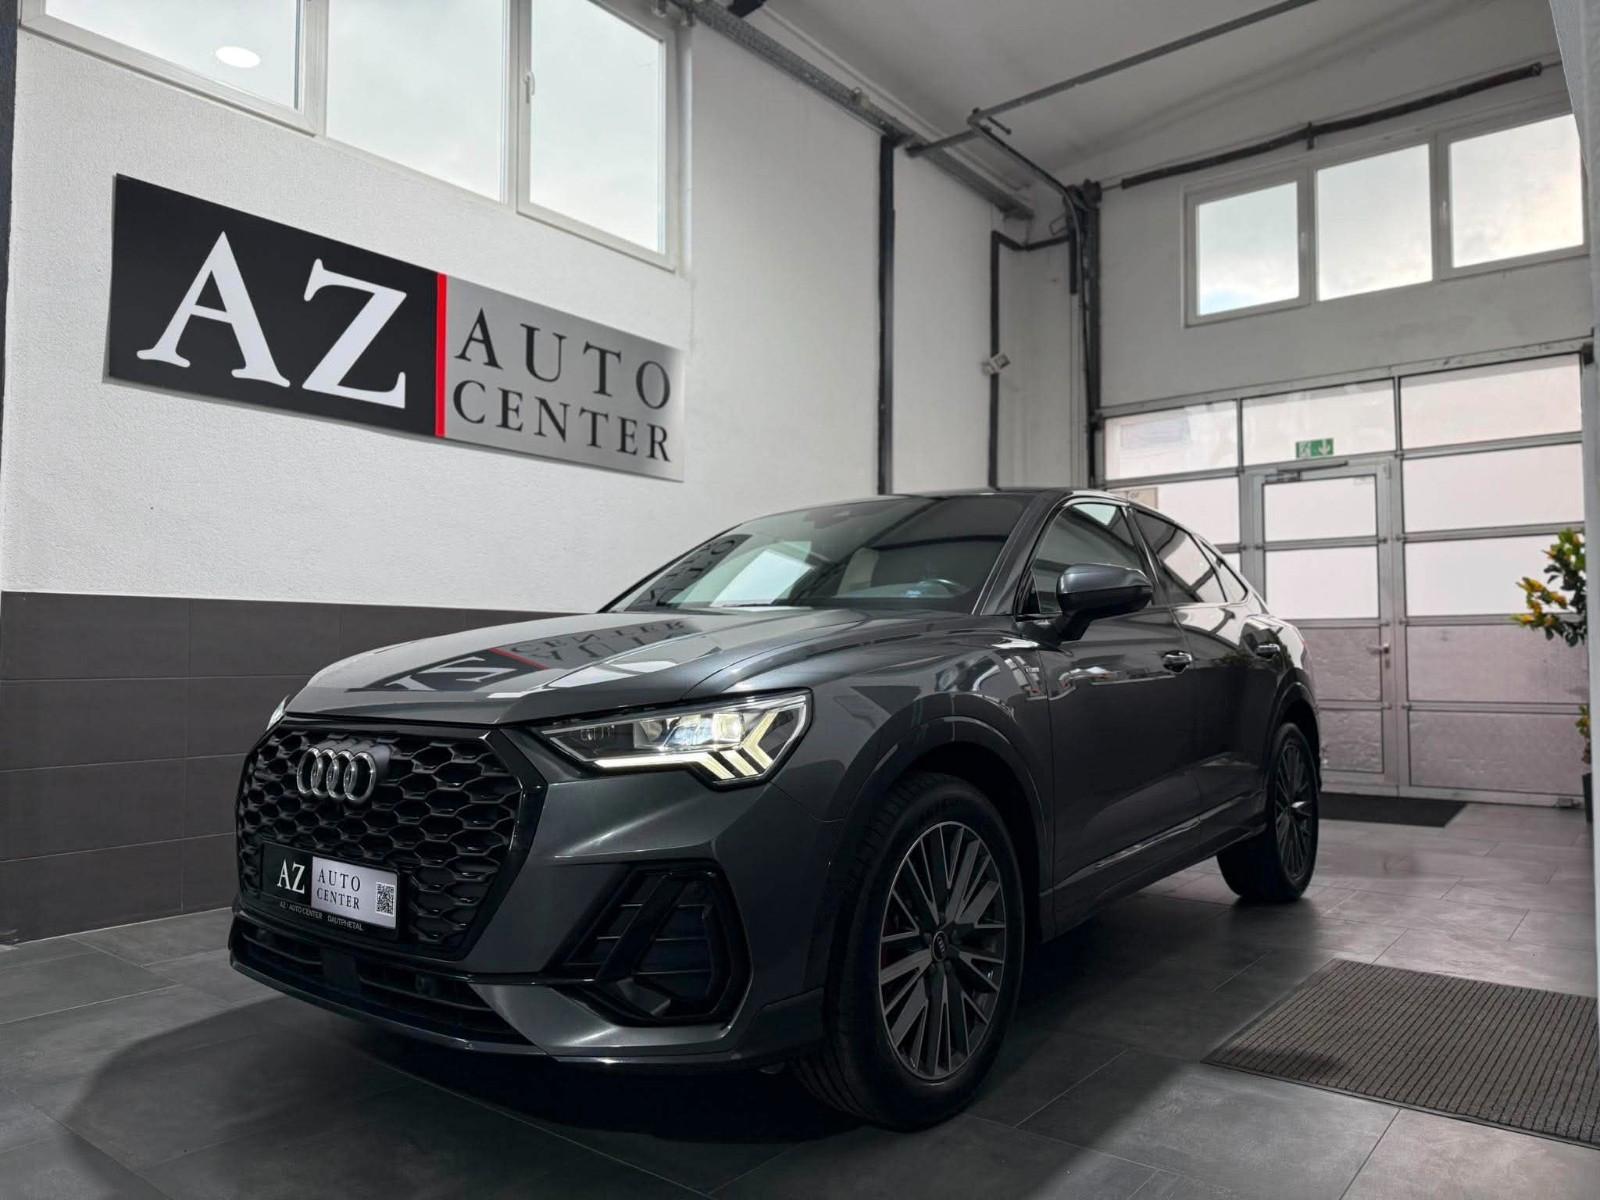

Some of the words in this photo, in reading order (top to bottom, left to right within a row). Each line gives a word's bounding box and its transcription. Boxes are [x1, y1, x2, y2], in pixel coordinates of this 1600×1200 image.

[136, 231, 407, 408] AZ
[454, 307, 671, 410] AUTO
[452, 379, 672, 462] CENTER
[277, 858, 305, 894] AZ
[316, 887, 360, 910] CENTER
[317, 868, 361, 892] AUTO
